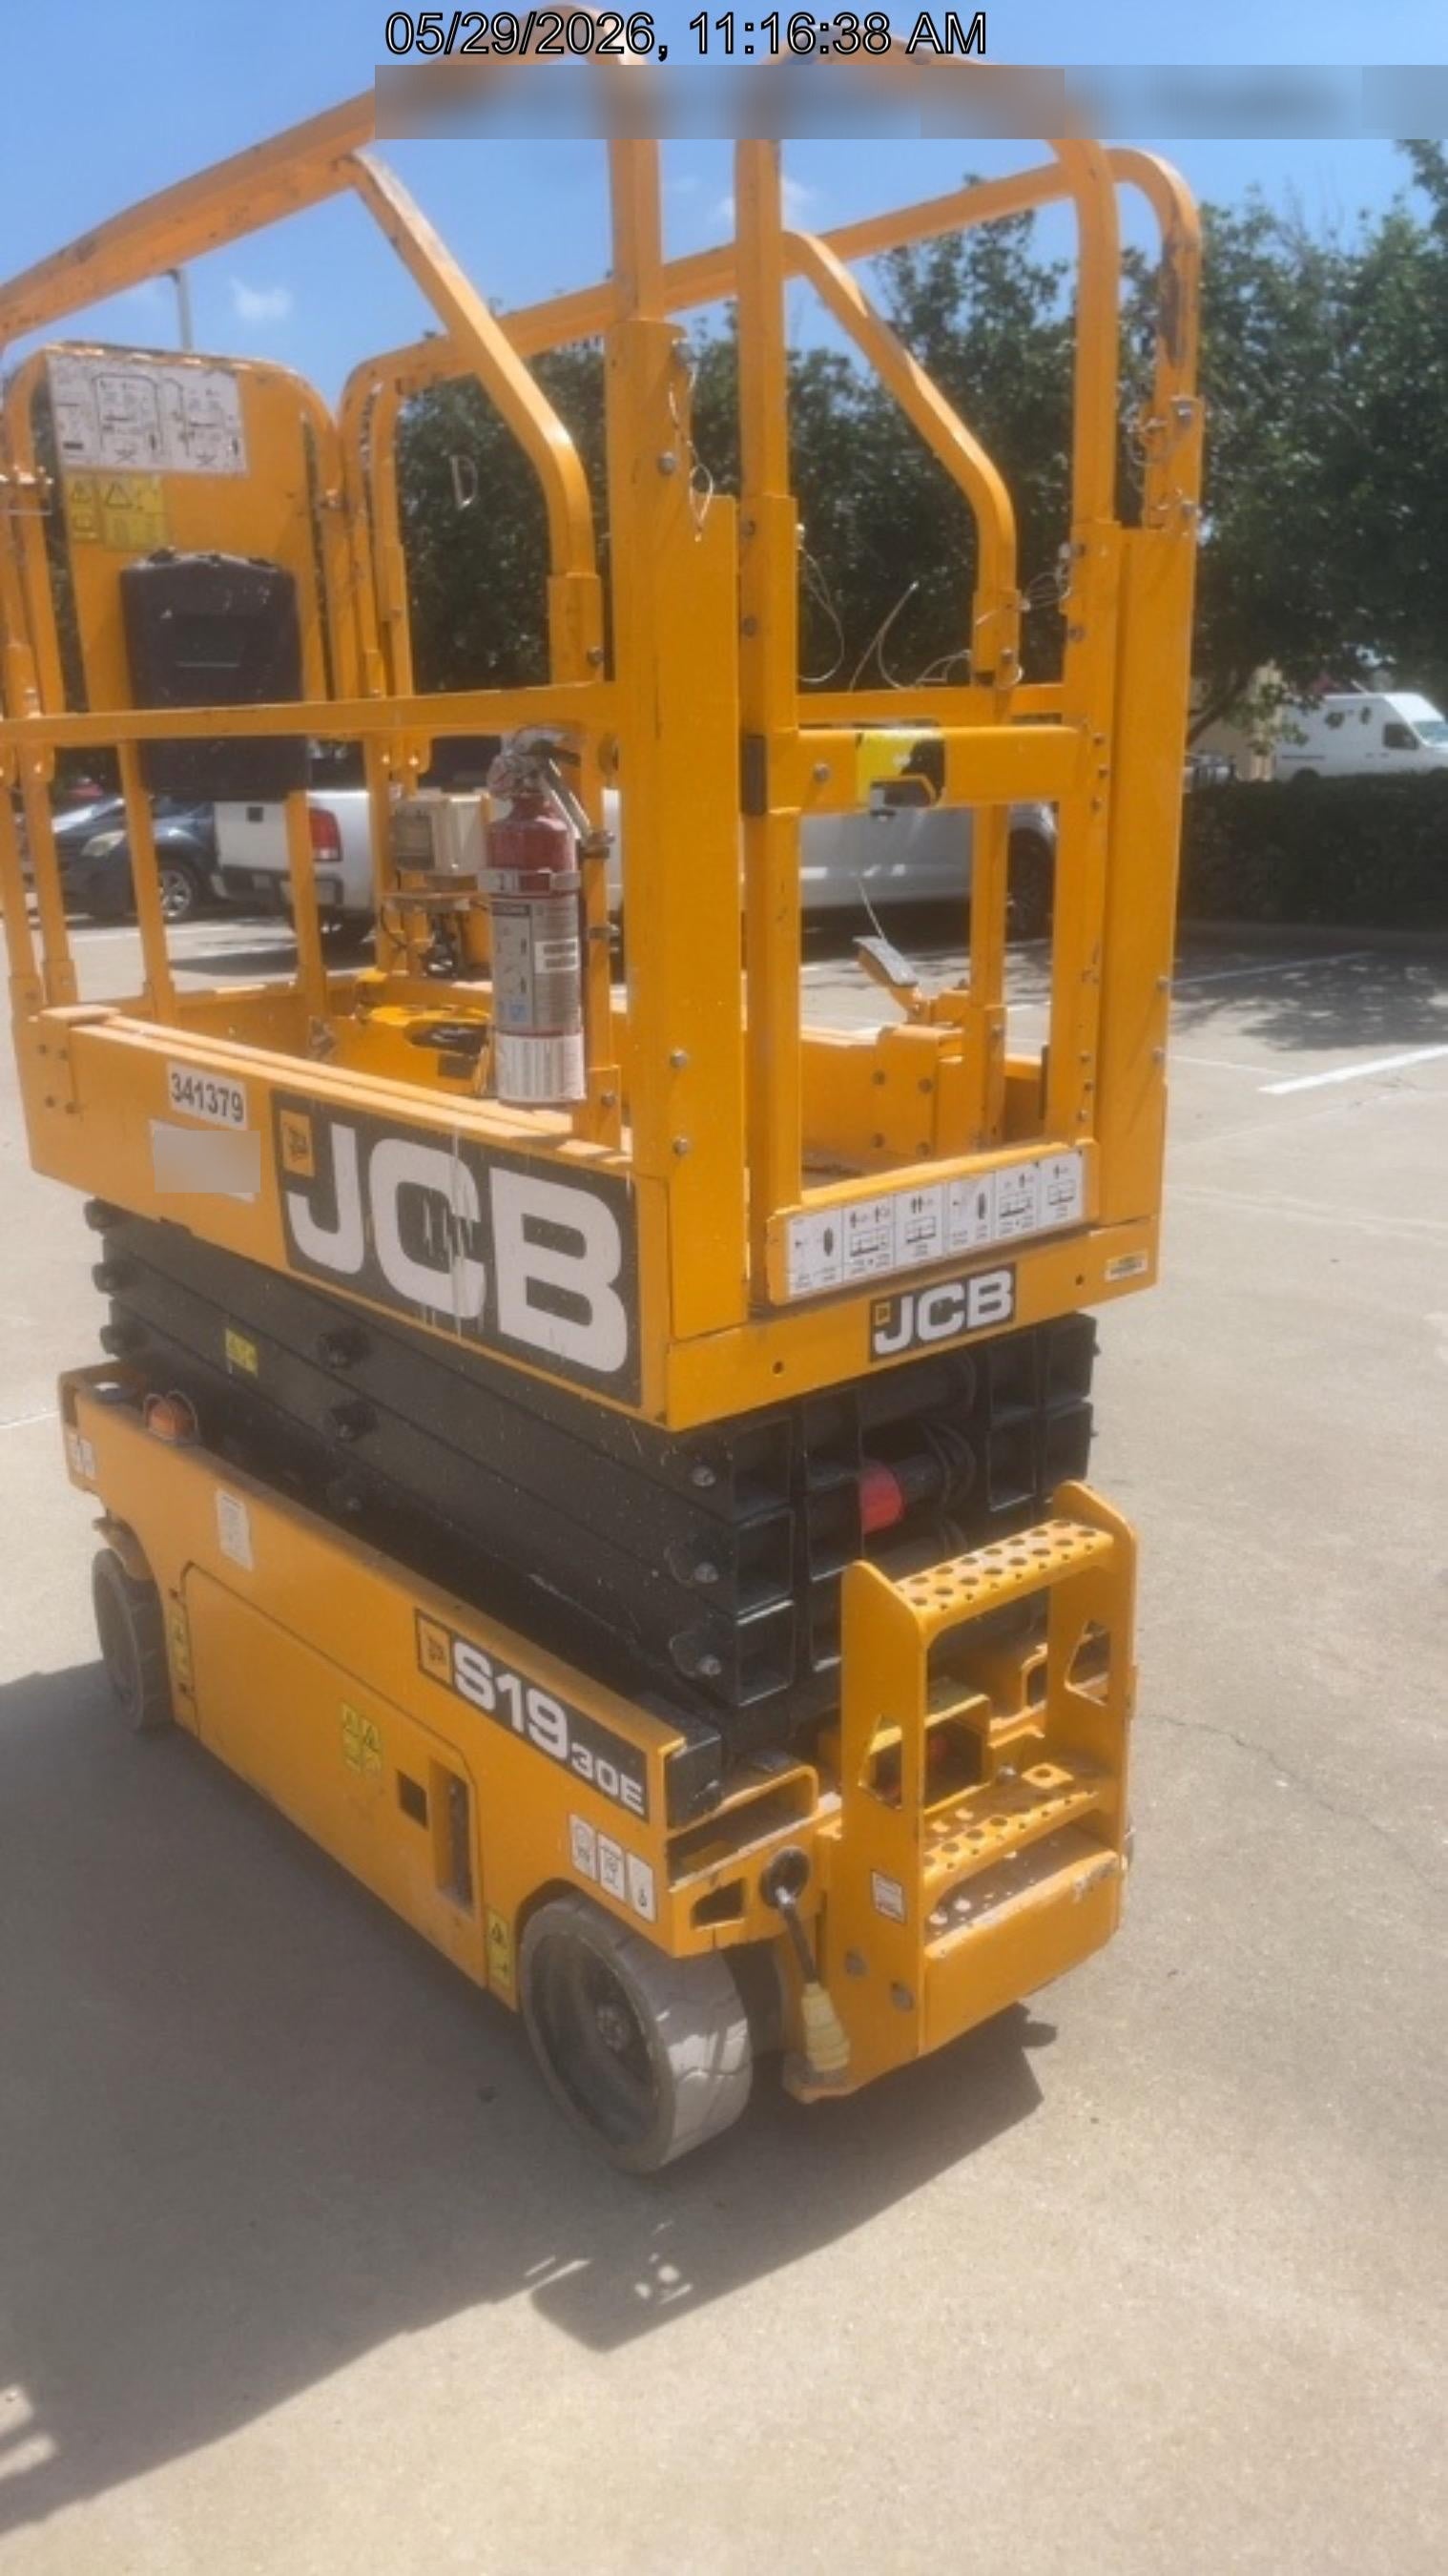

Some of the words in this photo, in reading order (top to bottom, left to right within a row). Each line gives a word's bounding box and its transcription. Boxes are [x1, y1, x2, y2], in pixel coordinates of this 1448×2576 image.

[172, 1072, 244, 1123] 341379
[286, 1122, 628, 1372] JCB
[874, 1269, 1012, 1355] JCB
